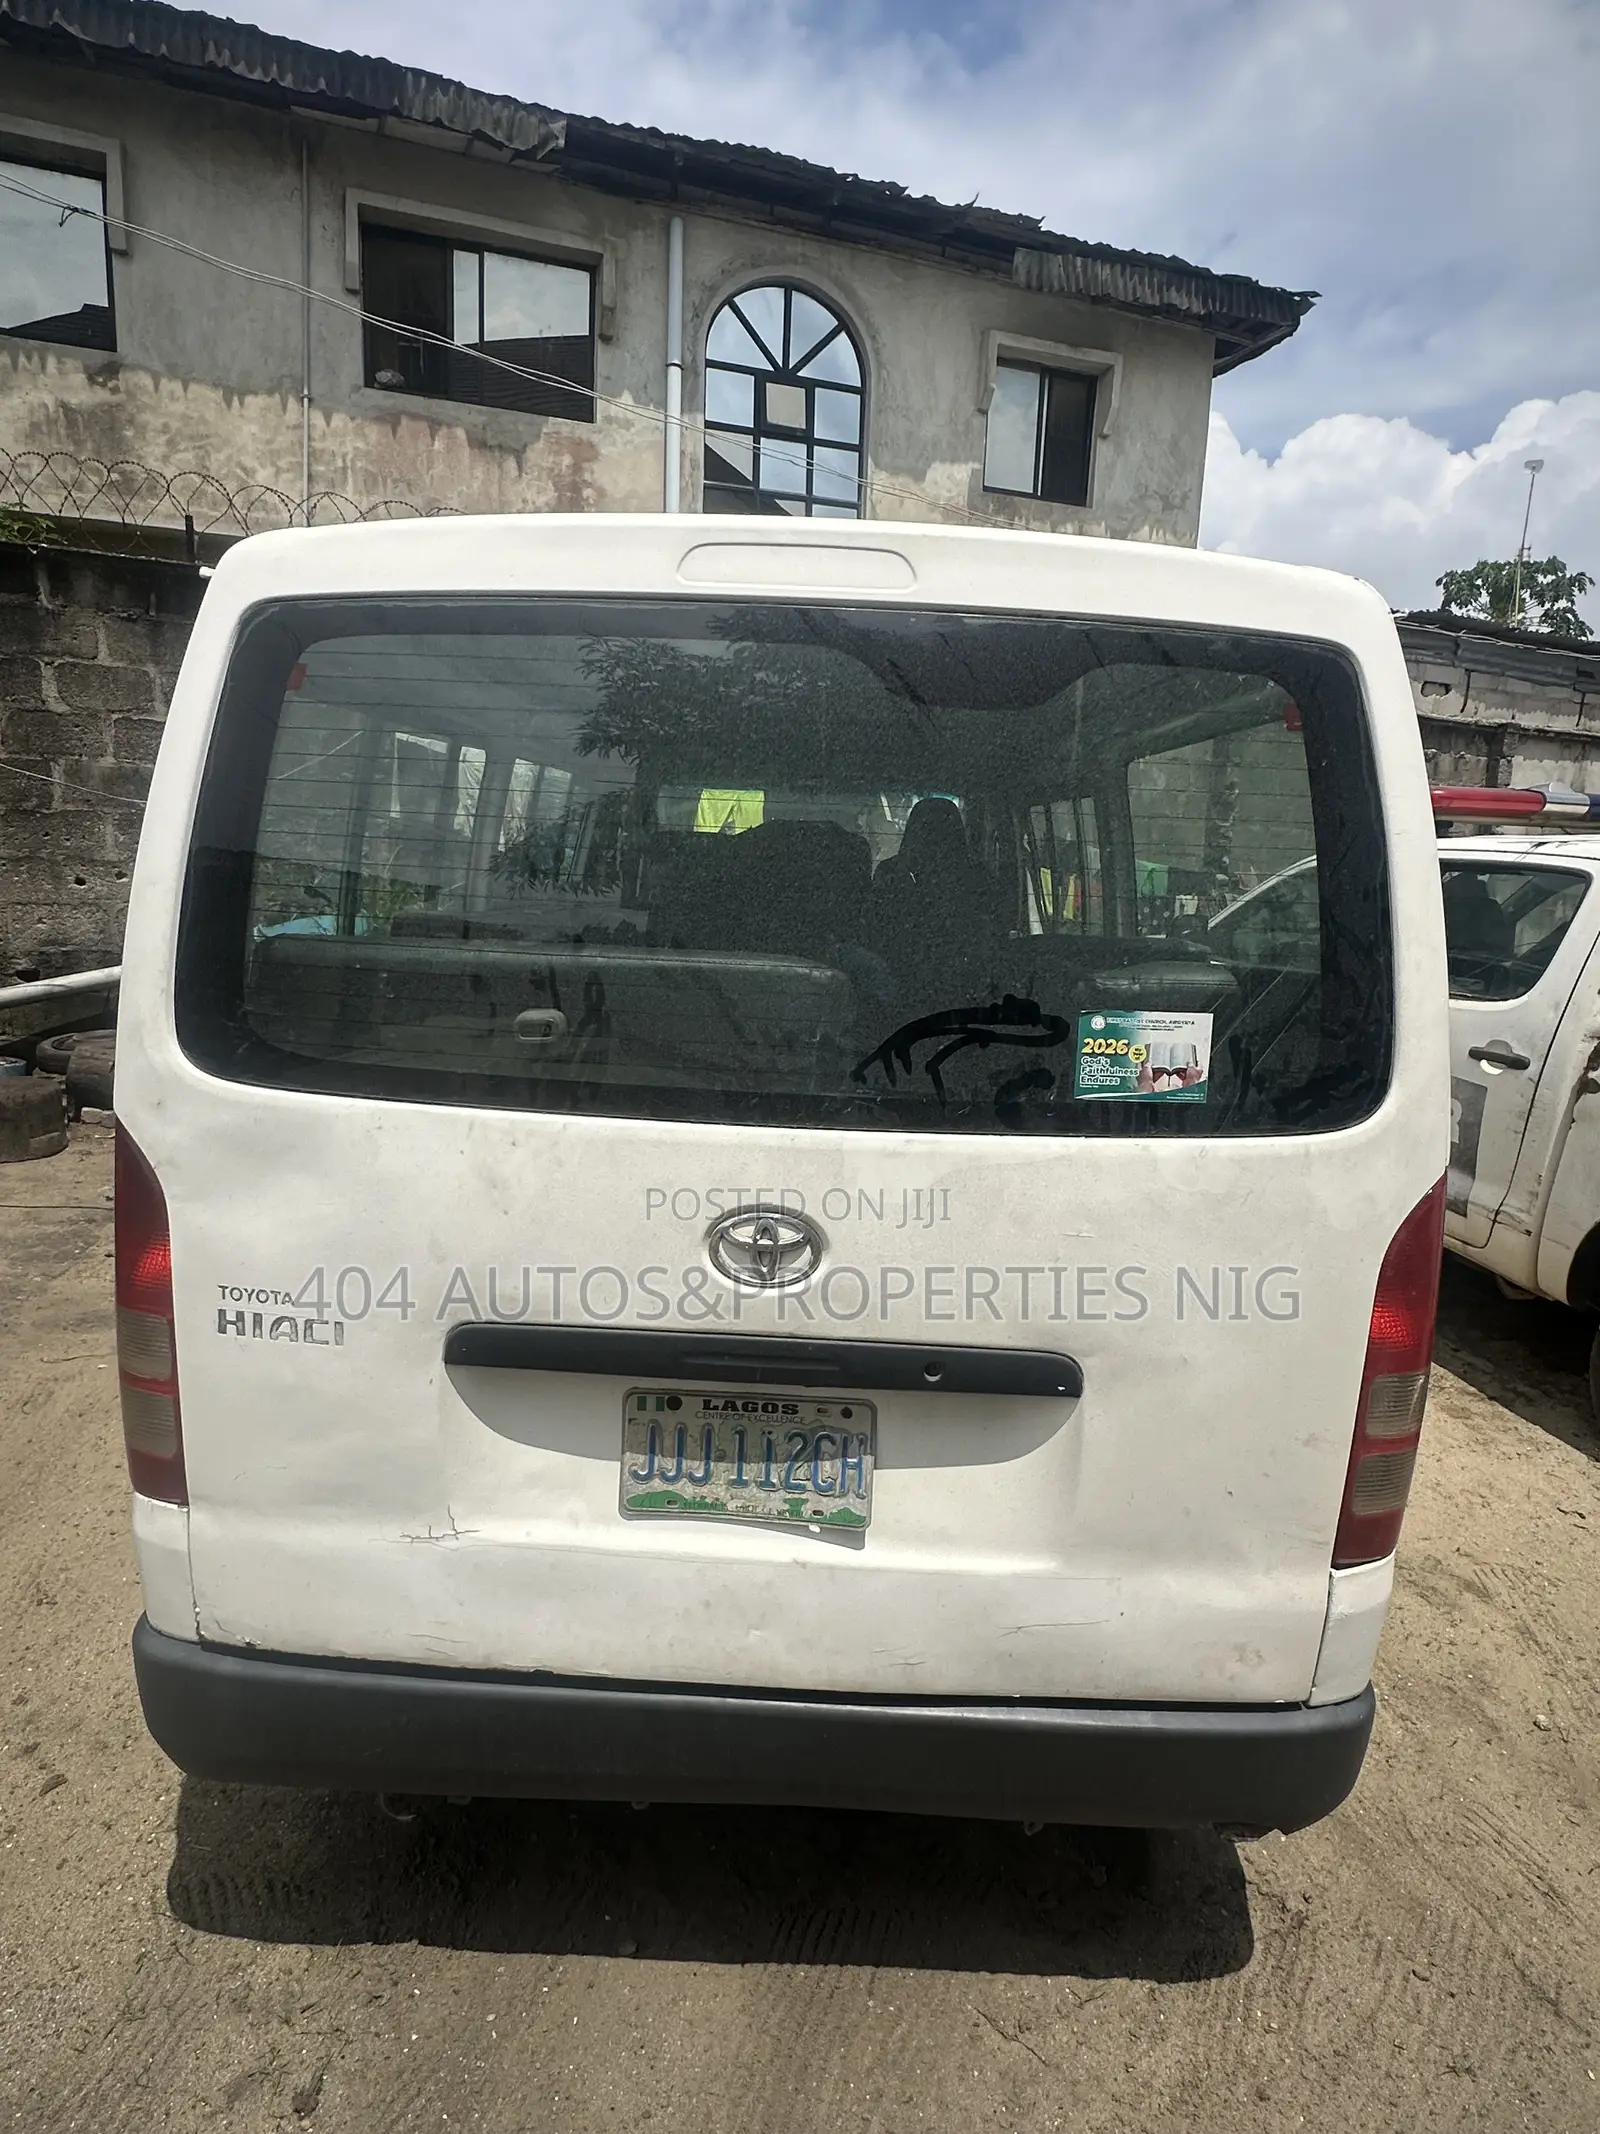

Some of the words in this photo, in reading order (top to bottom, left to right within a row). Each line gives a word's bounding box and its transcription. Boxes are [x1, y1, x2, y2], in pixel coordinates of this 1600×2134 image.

[1081, 1038, 1129, 1054] 2026
[1080, 1056, 1110, 1066] God's
[1080, 1066, 1139, 1076] Faithfulness
[1080, 1075, 1120, 1085] Endures
[217, 1285, 295, 1306] TOYOTA
[702, 1399, 800, 1415] LAGOS
